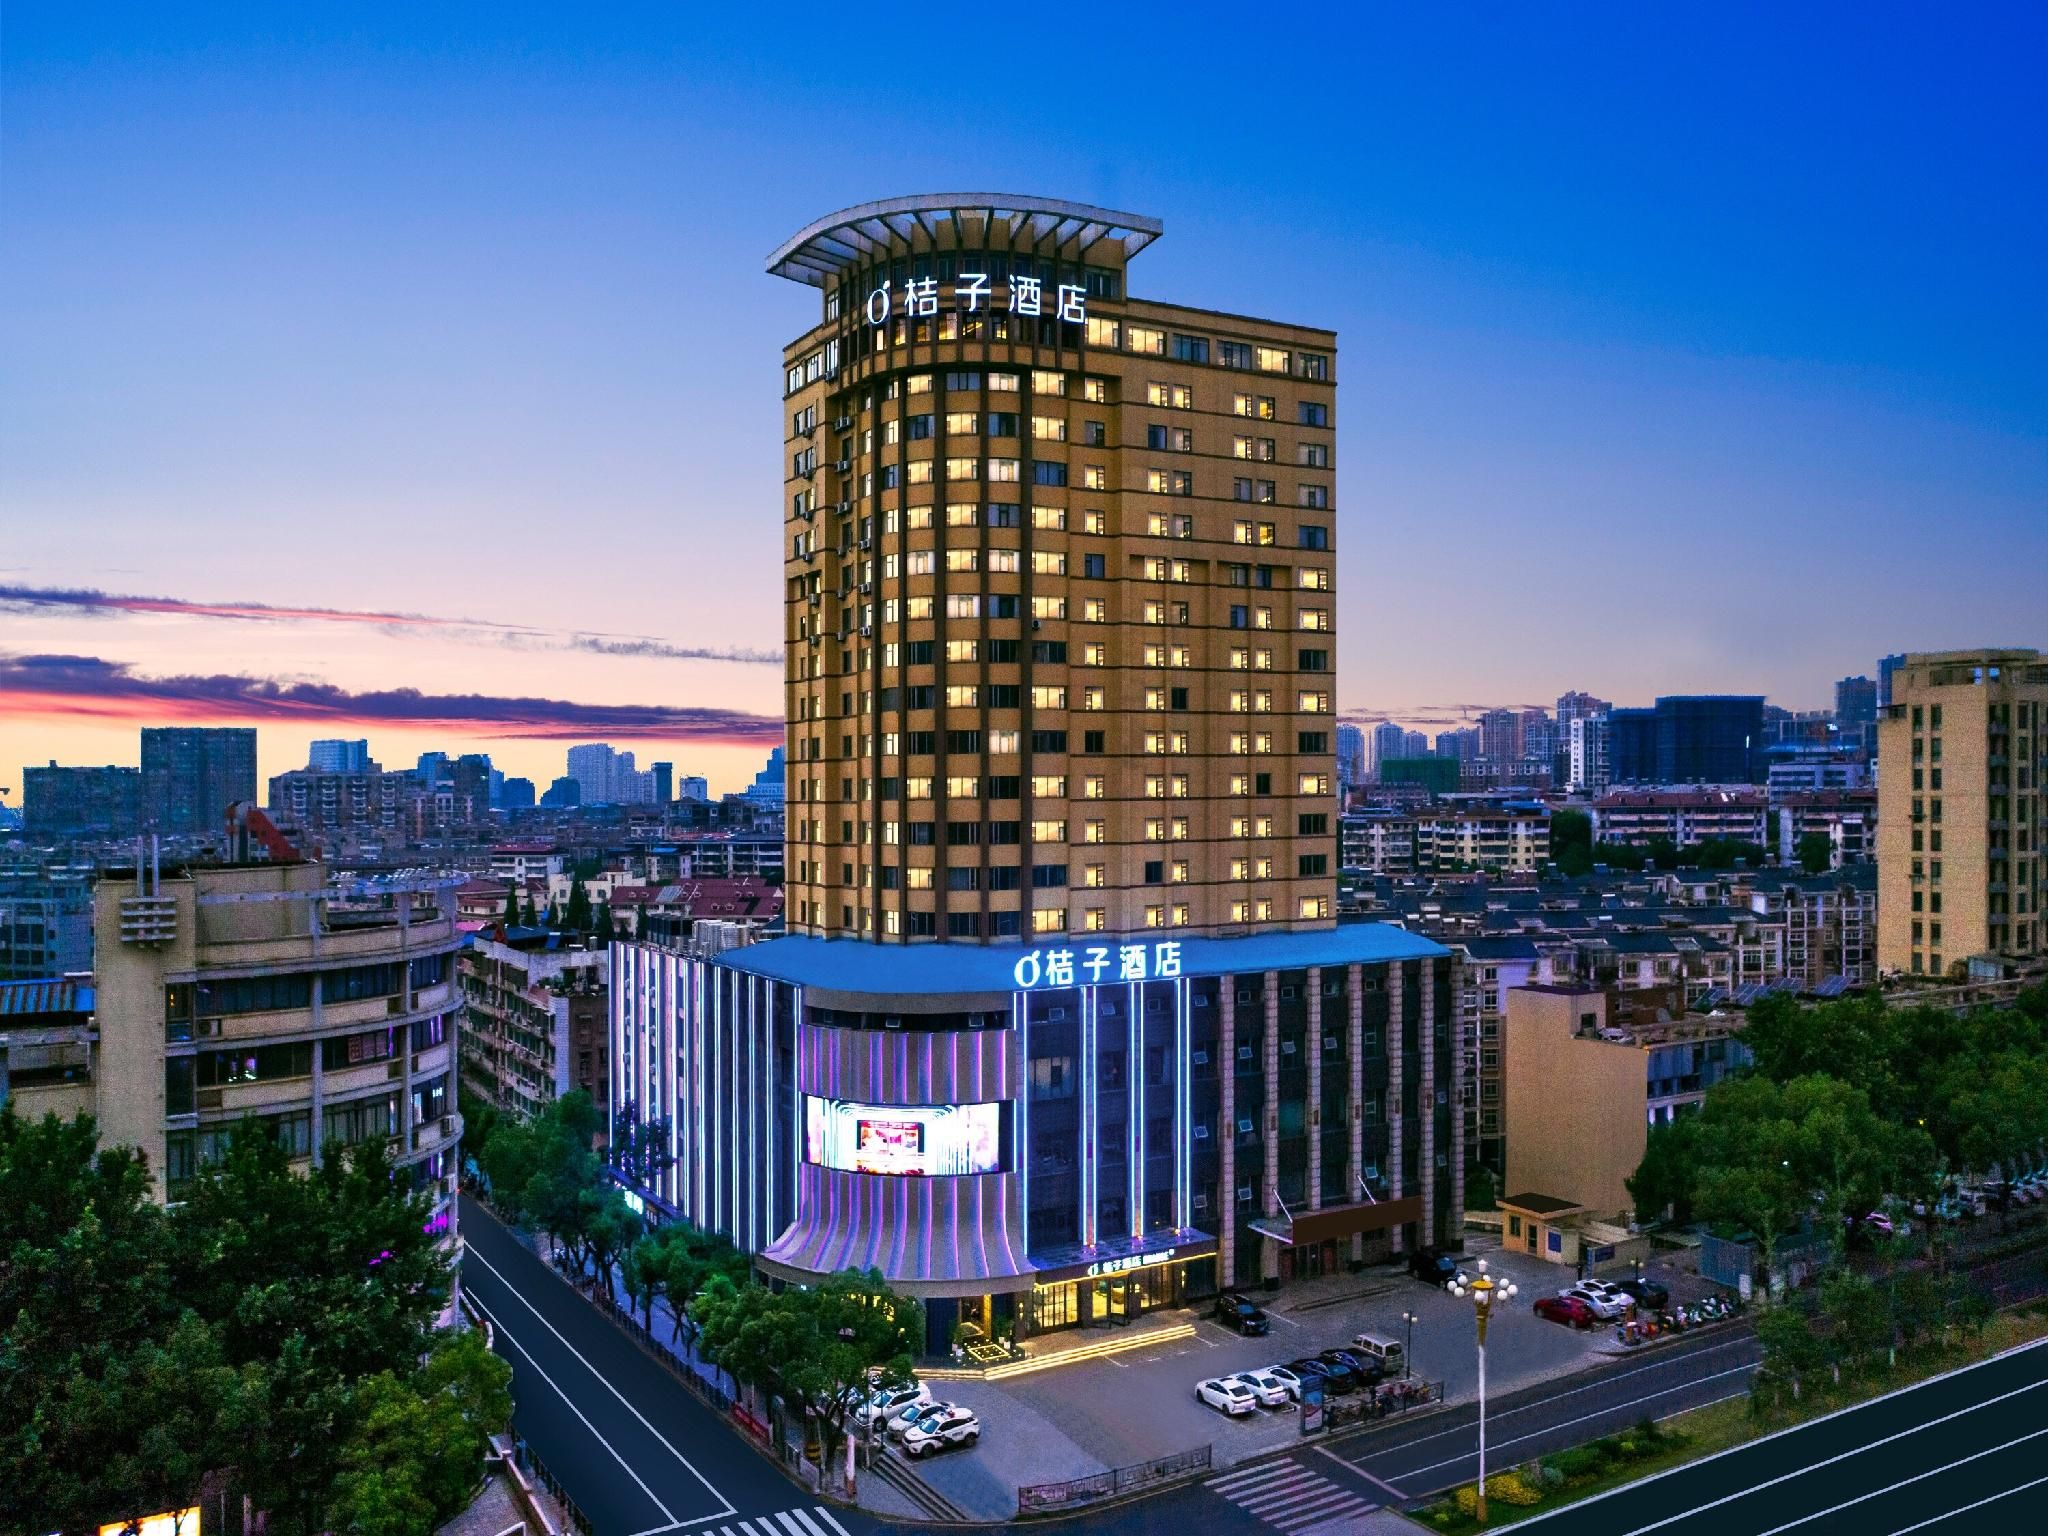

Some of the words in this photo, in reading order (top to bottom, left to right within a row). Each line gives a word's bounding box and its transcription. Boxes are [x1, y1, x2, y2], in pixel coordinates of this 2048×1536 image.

[904, 273, 1087, 323] 桔子酒店
[1046, 941, 1181, 986] 桔子酒店
